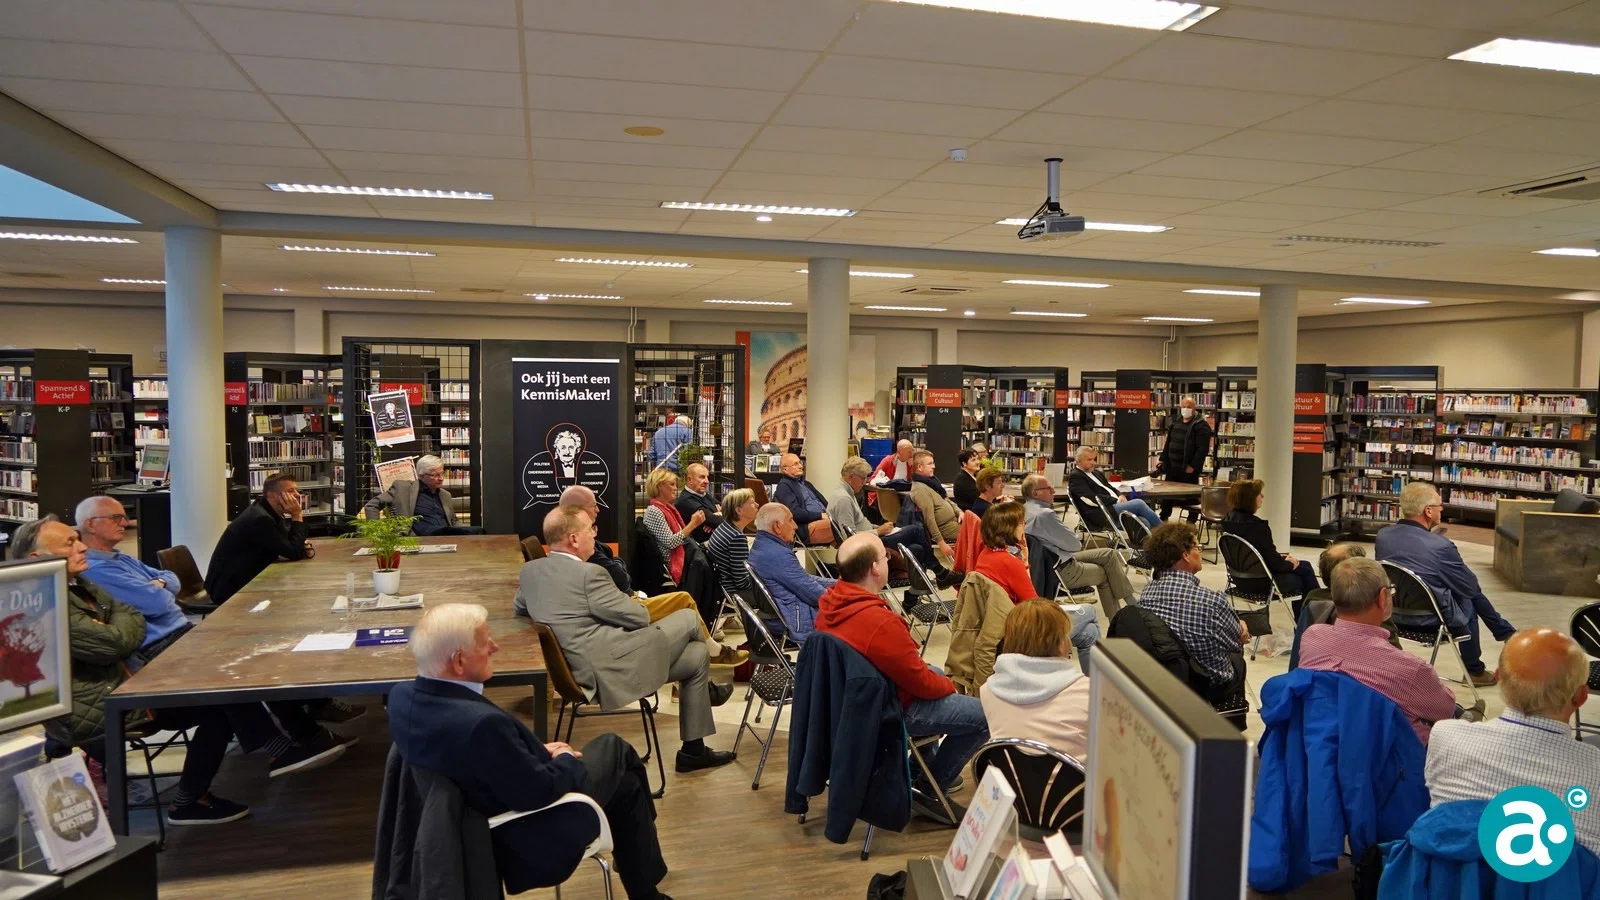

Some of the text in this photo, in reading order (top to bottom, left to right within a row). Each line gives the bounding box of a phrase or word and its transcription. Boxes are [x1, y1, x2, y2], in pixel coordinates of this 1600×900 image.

[521, 372, 610, 387] Ook jij bent een
[40, 384, 78, 392] Spannend
[521, 388, 610, 400] KennisMaker!
